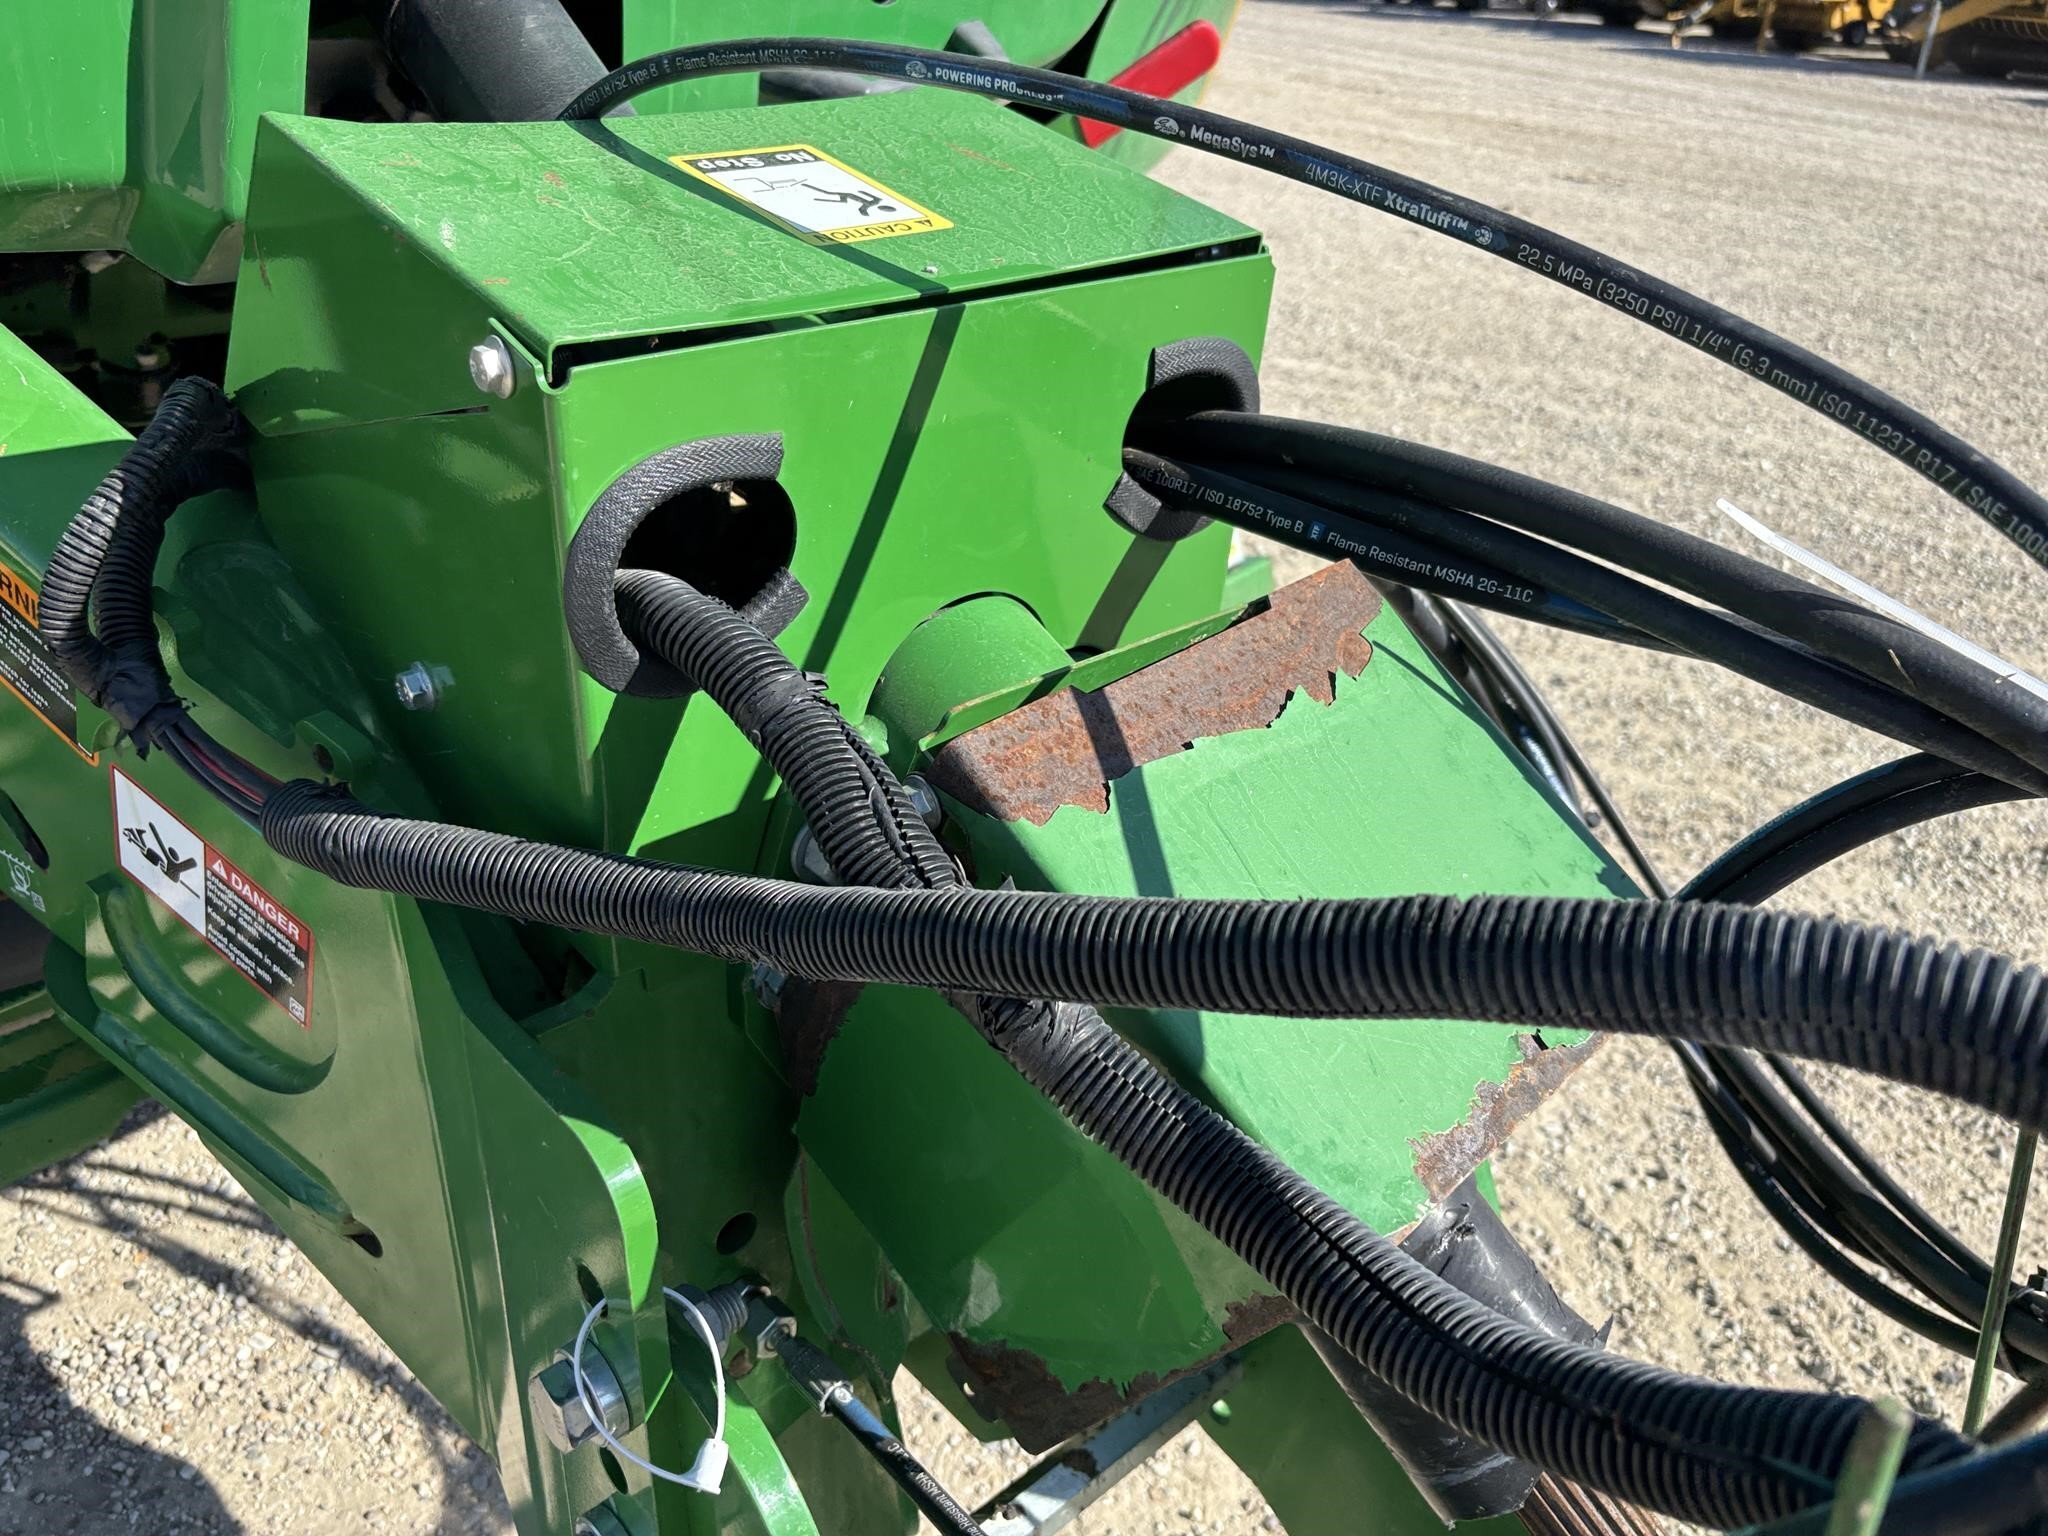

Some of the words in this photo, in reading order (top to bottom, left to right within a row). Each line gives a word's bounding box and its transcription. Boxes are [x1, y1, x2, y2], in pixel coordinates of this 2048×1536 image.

[627, 68, 650, 85] Type
[649, 62, 659, 77] B
[675, 55, 708, 71] Flame
[708, 50, 759, 67] Resistant
[759, 48, 792, 64] MSHA
[935, 66, 992, 90] POWERING
[697, 157, 765, 169] Step
[775, 151, 816, 163] No
[1305, 162, 1383, 201] 4M3K-XTF
[814, 222, 913, 243] CAUTION
[1517, 243, 1553, 273] 22.5
[1557, 261, 1594, 292] MPa
[1596, 277, 1649, 317] (3250
[1650, 304, 1689, 337] PSI)
[1731, 343, 1770, 377] (6.3
[1770, 369, 1819, 404] mm)
[1818, 390, 1852, 420] ISO
[1852, 411, 1917, 458] 11237
[1914, 449, 1957, 484] R17
[1966, 486, 2008, 523] SAE
[1154, 472, 1198, 495] 100R17
[1204, 487, 1225, 505] ISO
[1224, 496, 1264, 519] 18752
[1266, 508, 1292, 531] Type
[1294, 519, 1304, 534] B
[1327, 532, 1367, 557] Flame
[1368, 545, 1432, 576] Resistant
[1434, 564, 1475, 589] MSHA
[1476, 577, 1534, 604] 2G-11C
[206, 869, 257, 918] Entanglement
[258, 912, 266, 926] in
[266, 922, 296, 953] rotating
[207, 888, 228, 912] injury
[228, 908, 238, 919] or
[231, 871, 300, 941] DANGER
[206, 880, 238, 911] driveline
[239, 908, 253, 924] can
[253, 921, 276, 944] cause
[277, 941, 305, 969] serious
[207, 905, 226, 927] Keep
[226, 924, 236, 936] all
[236, 932, 264, 960] shields
[264, 954, 272, 967] in
[208, 932, 236, 963] rotating
[208, 923, 228, 945] Avoid
[228, 942, 256, 970] contact
[256, 966, 273, 984] with
